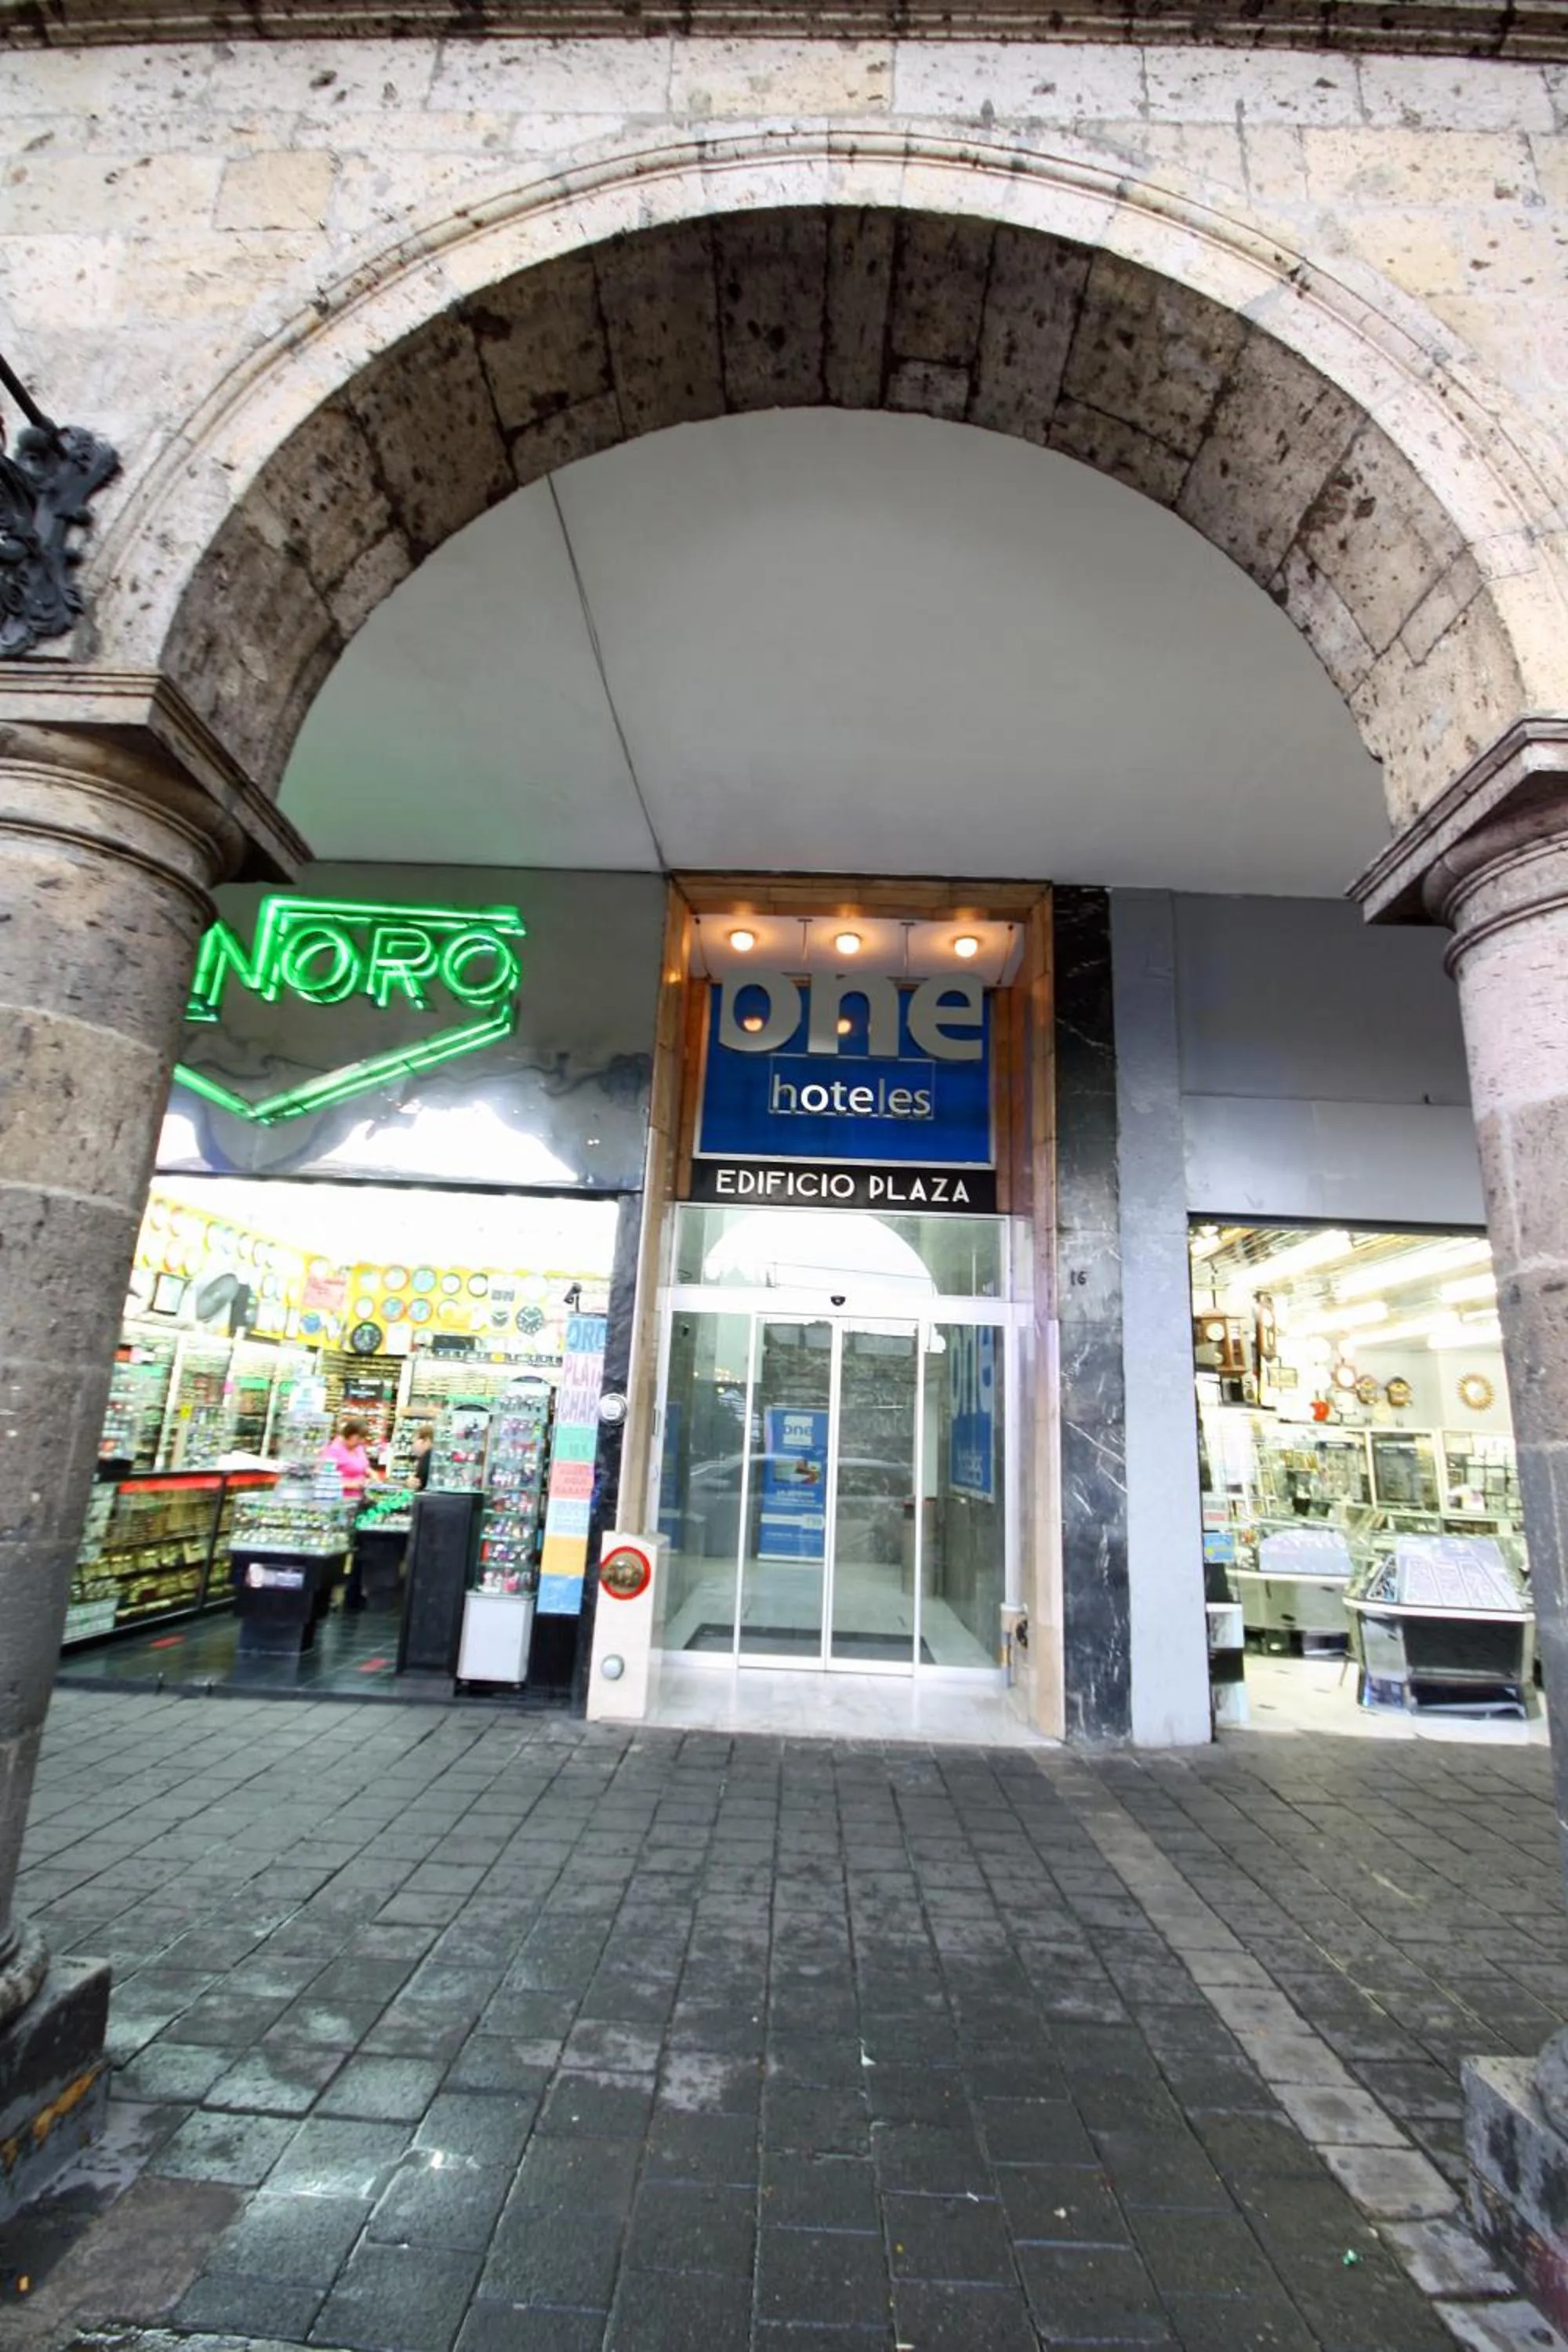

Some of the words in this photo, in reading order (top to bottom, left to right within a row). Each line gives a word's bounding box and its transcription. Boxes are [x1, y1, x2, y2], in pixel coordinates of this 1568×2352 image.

[719, 971, 984, 1060] one
[772, 1073, 931, 1116] hoteles
[715, 1169, 855, 1199] EDIFICIO
[869, 1175, 971, 1203] PLAZA
[1069, 1269, 1088, 1287] 16
